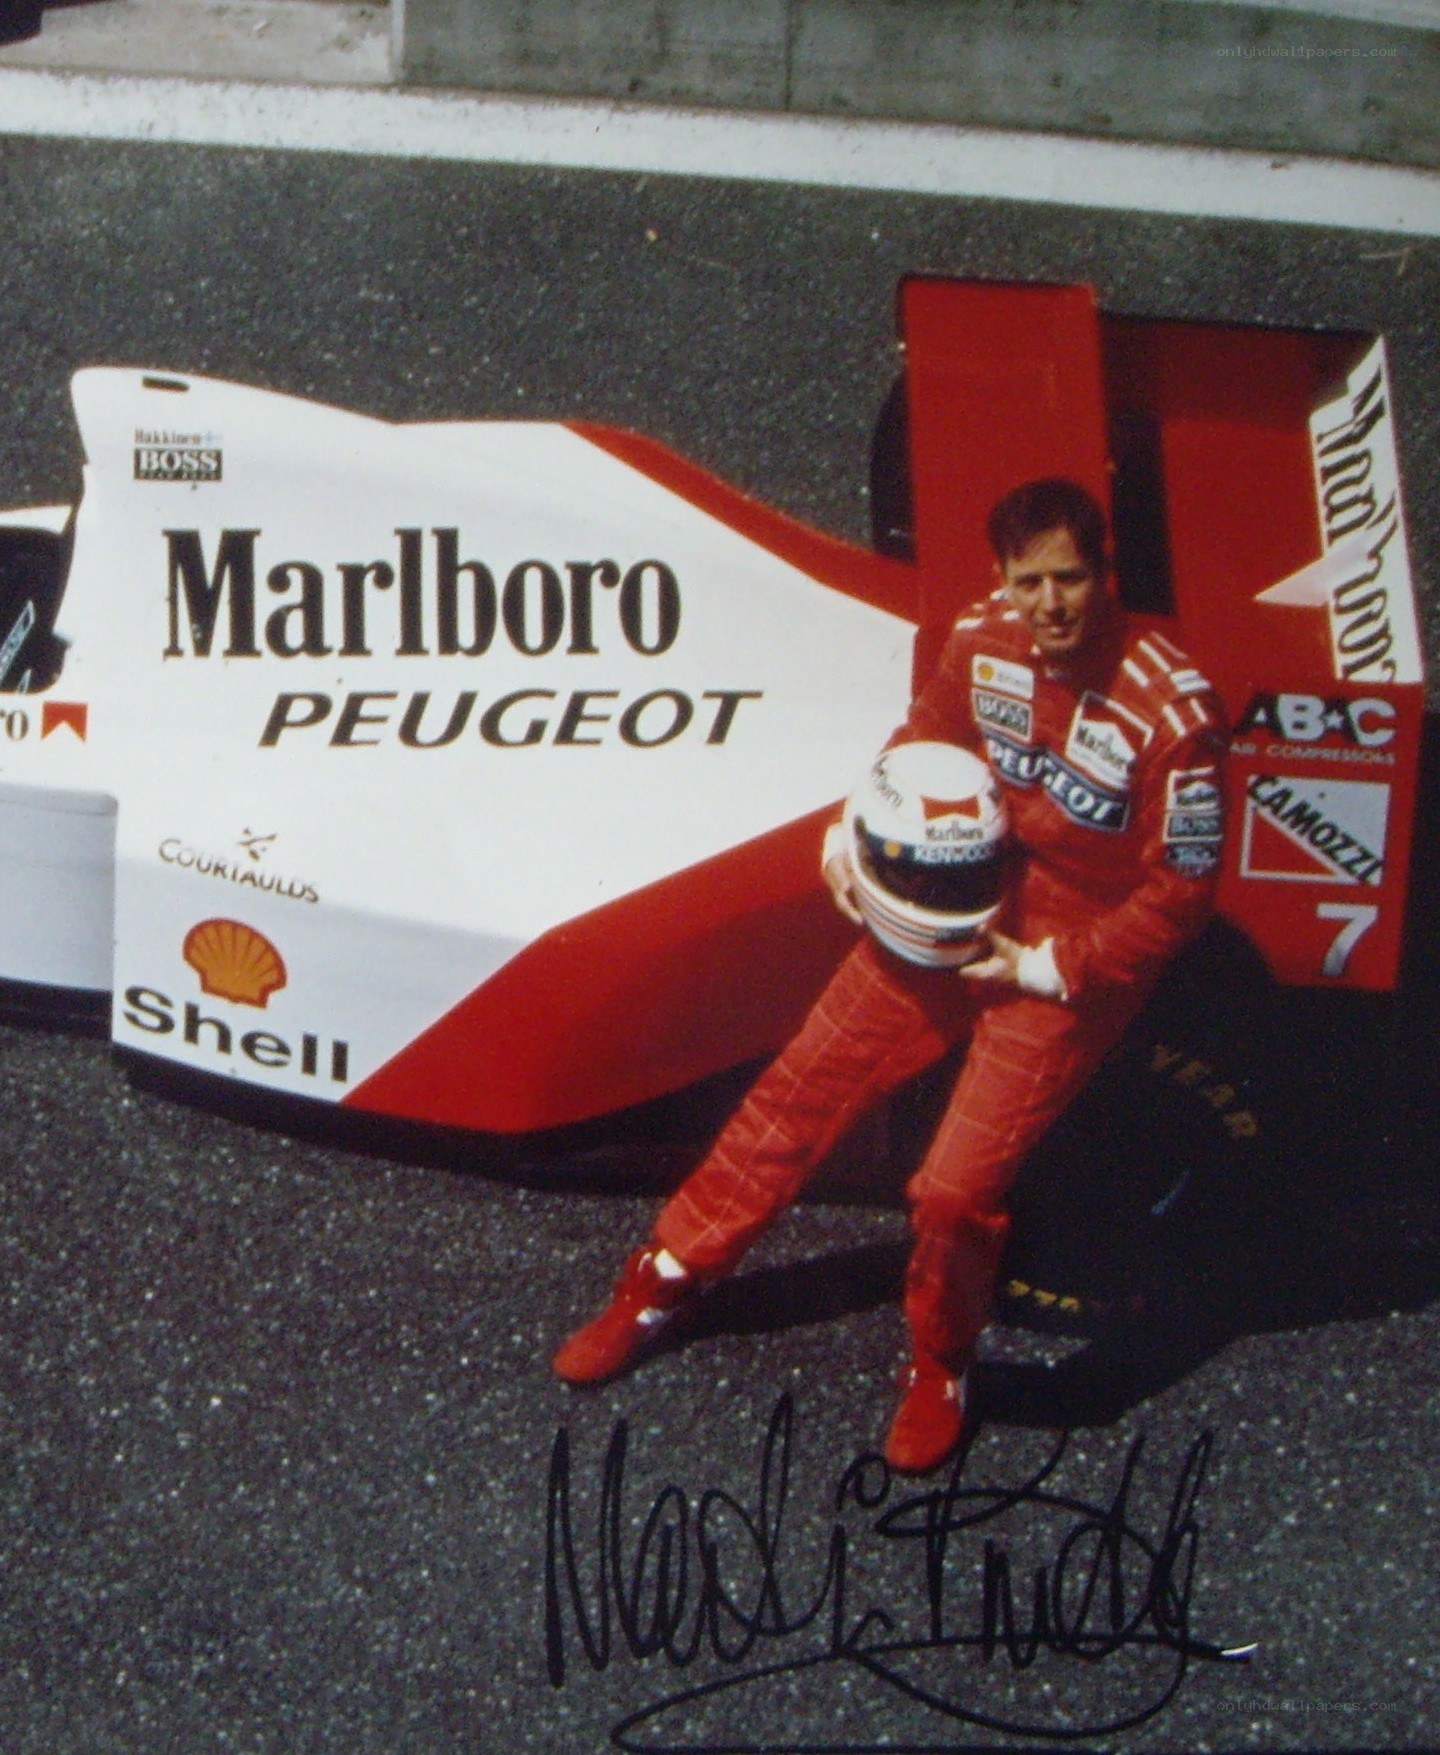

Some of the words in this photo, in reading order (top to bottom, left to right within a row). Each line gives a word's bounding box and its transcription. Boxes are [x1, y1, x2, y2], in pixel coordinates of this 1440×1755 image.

[139, 449, 219, 471] BOSS
[162, 527, 682, 659] Marlboro
[258, 689, 763, 749] PEUGEOT
[1316, 902, 1379, 977] 7
[123, 985, 350, 1083] Shell
